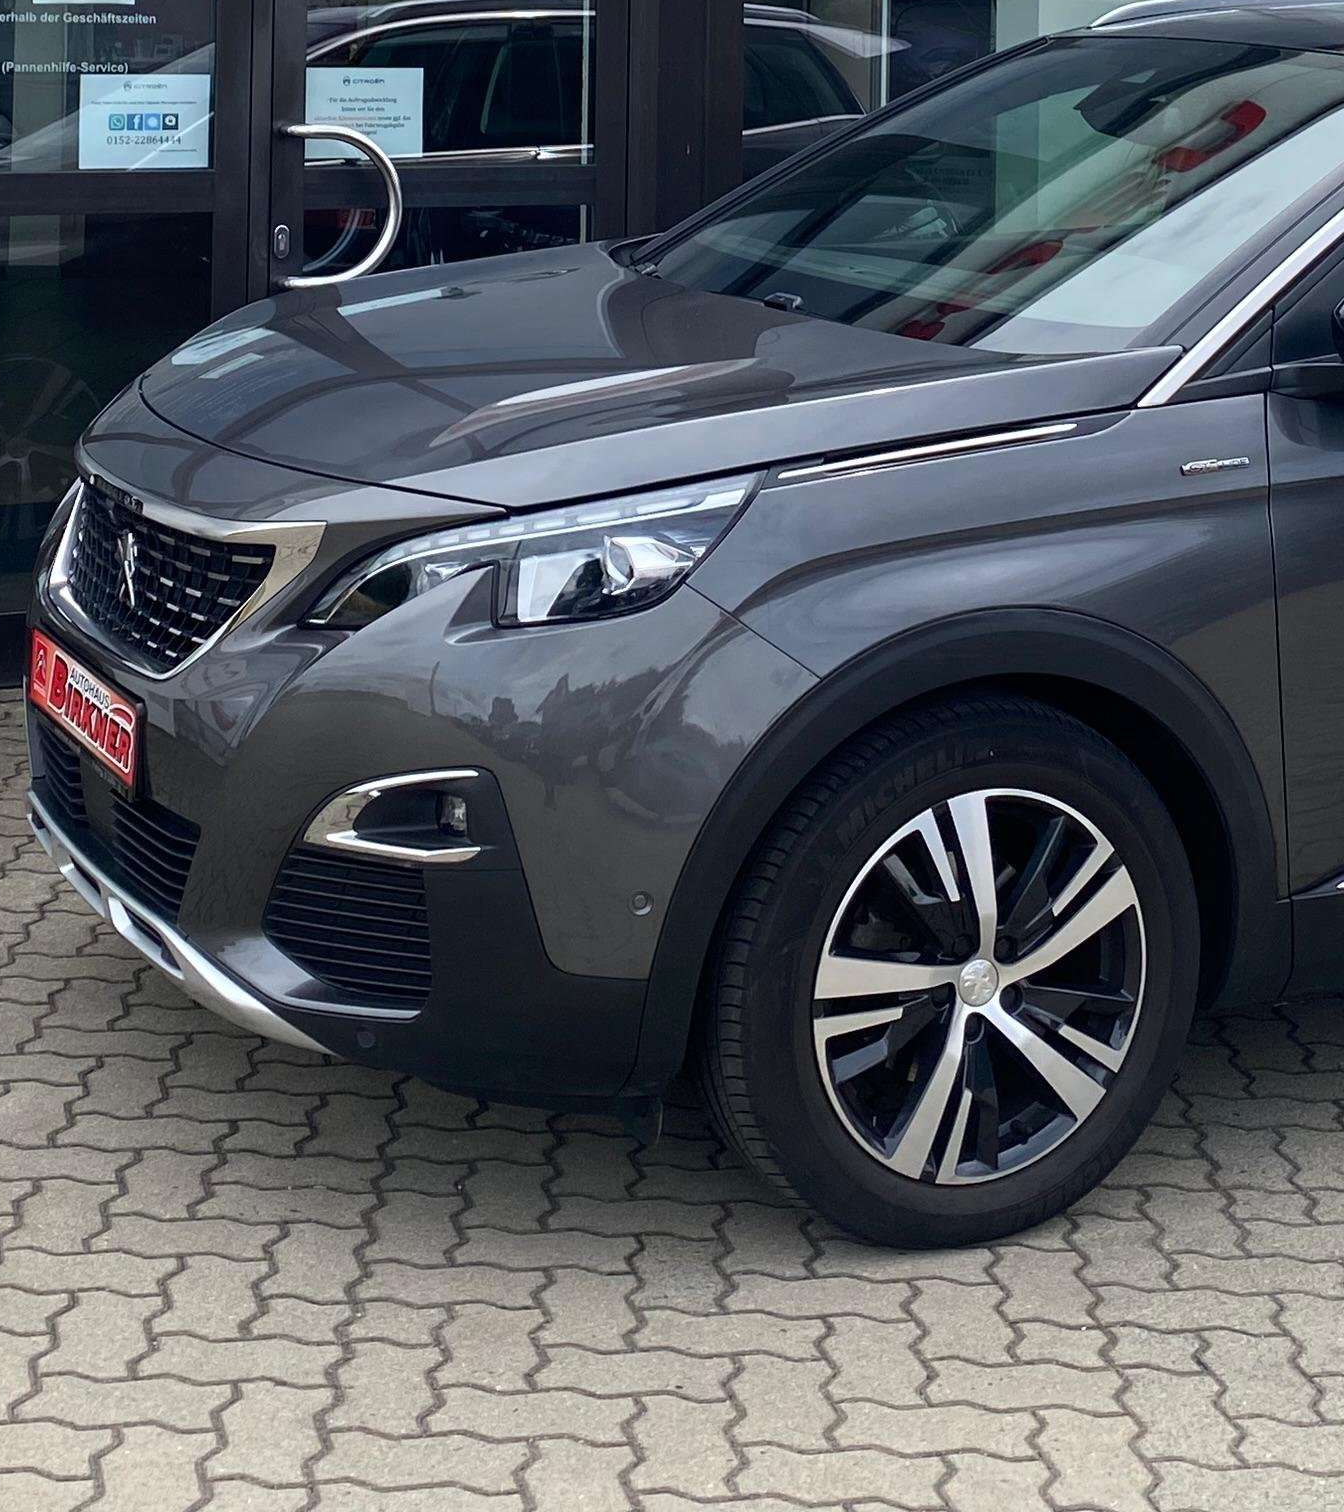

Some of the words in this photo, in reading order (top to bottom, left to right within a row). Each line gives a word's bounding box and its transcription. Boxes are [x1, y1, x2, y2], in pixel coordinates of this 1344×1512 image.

[40, 12, 60, 23] der
[63, 11, 157, 24] Geschäftszeiten
[1, 61, 129, 75] (Pannenhilfe-Service)
[69, 667, 111, 710] AUTOHAUS
[48, 653, 133, 773] BIRKNER
